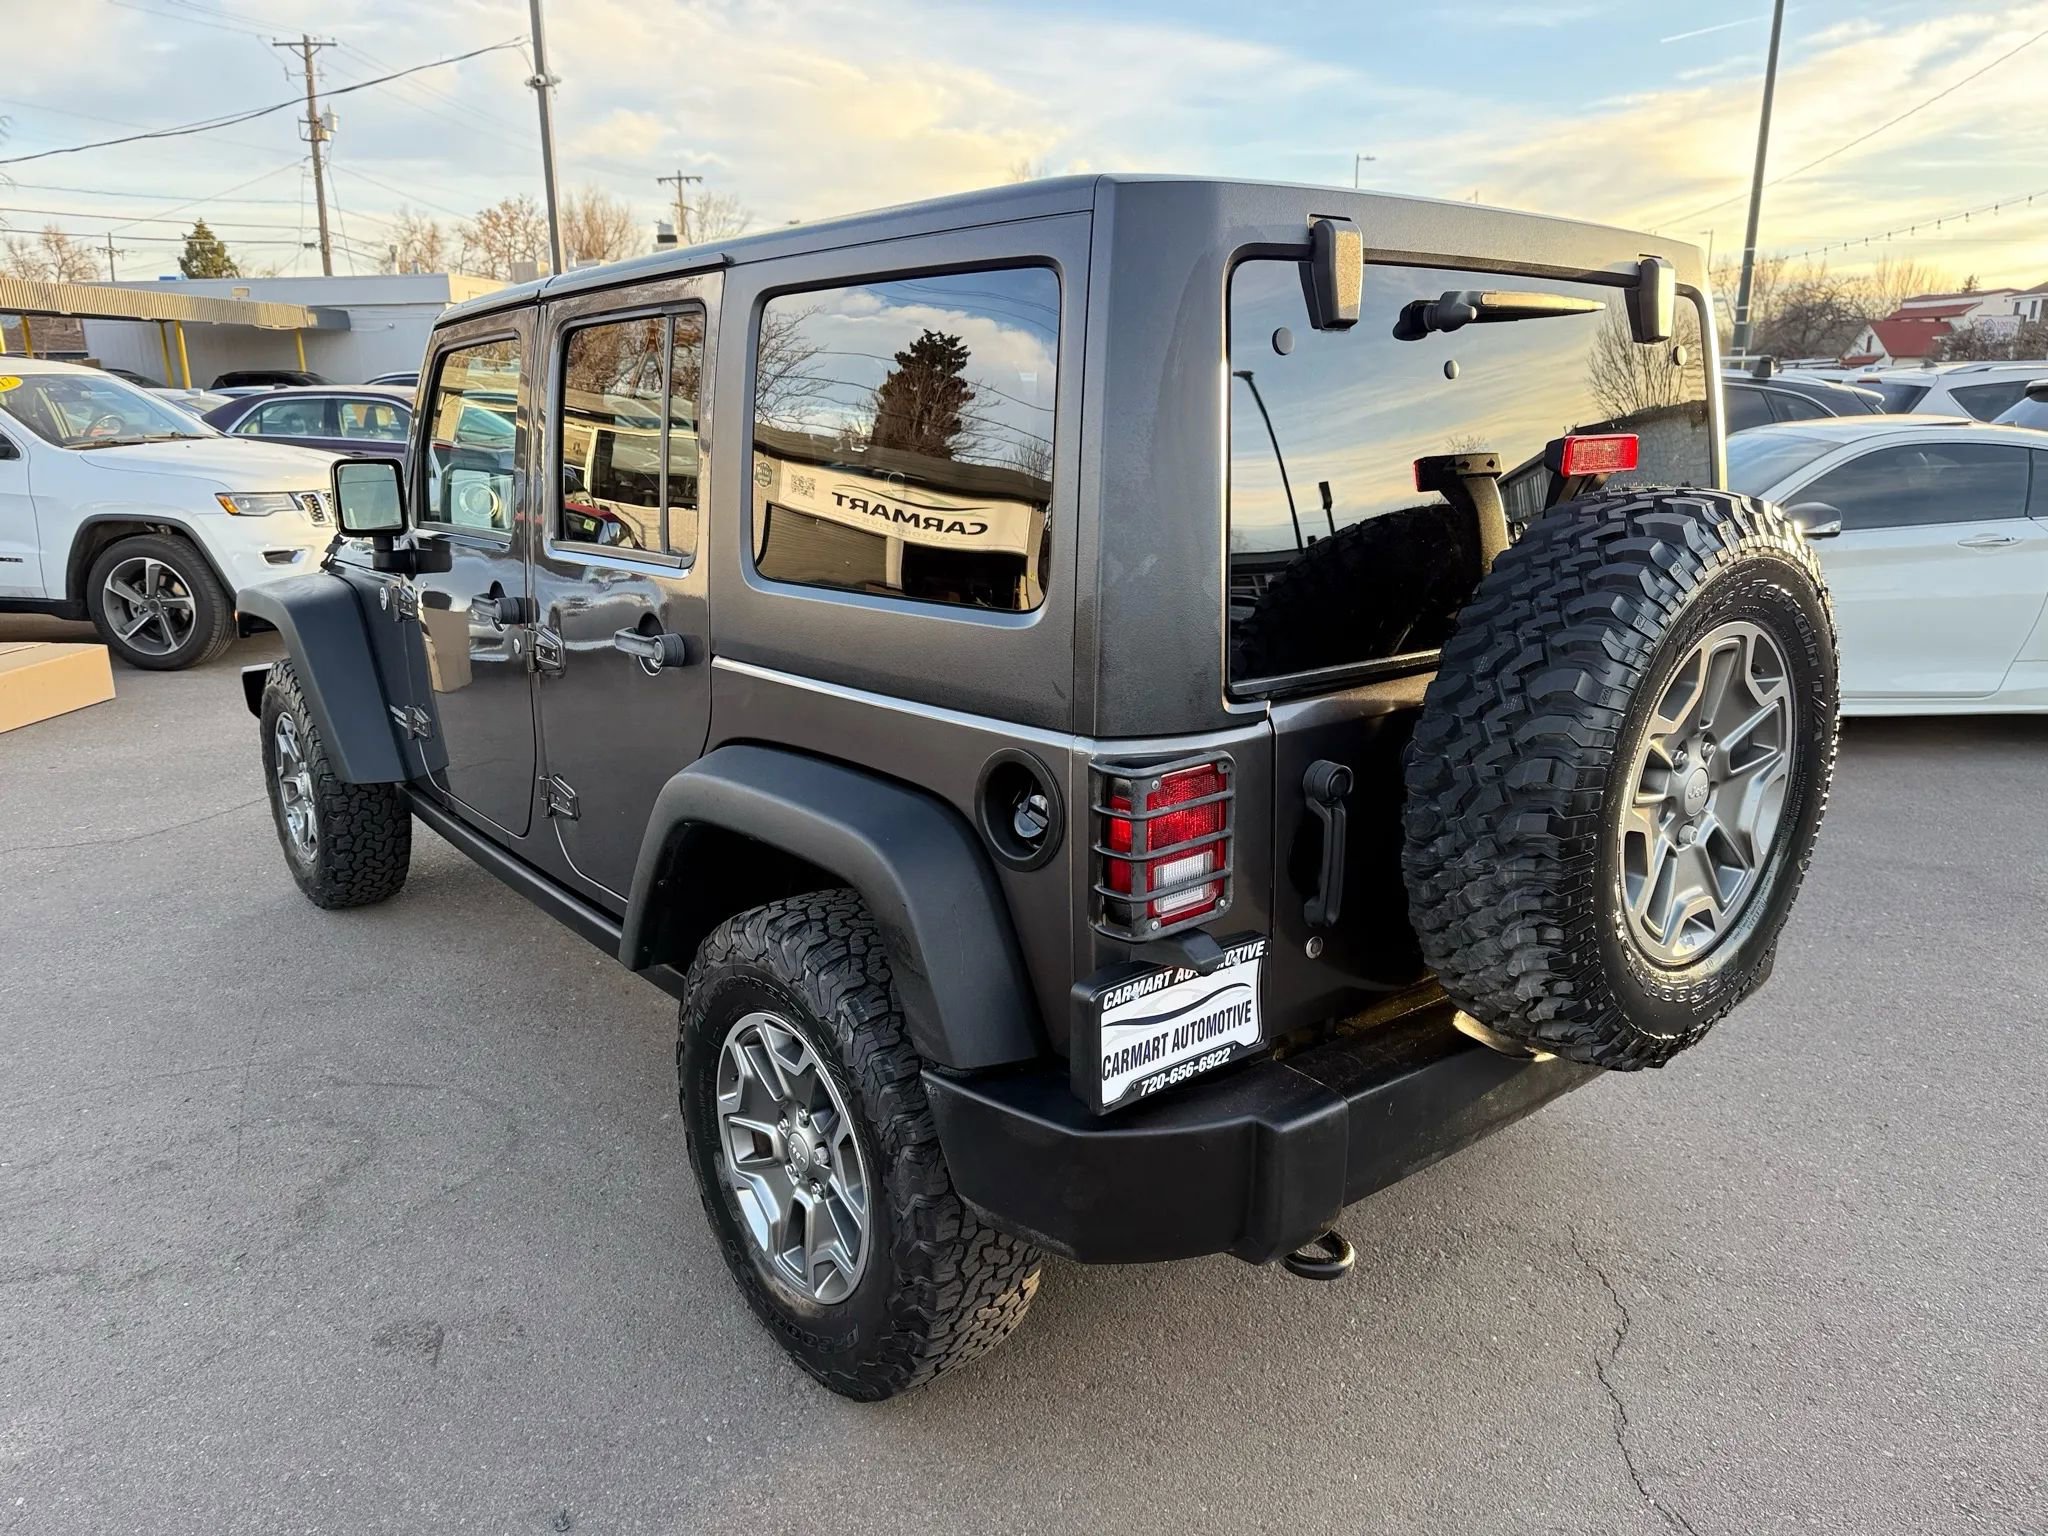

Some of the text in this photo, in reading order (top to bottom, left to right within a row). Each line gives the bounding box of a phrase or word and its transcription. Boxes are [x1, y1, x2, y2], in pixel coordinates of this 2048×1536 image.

[1103, 940, 1266, 1010] CARMART AUOTIVE
[1102, 1000, 1252, 1081] CARMART AUTOMOTIVE
[1140, 1047, 1231, 1097] 720-656-6922
